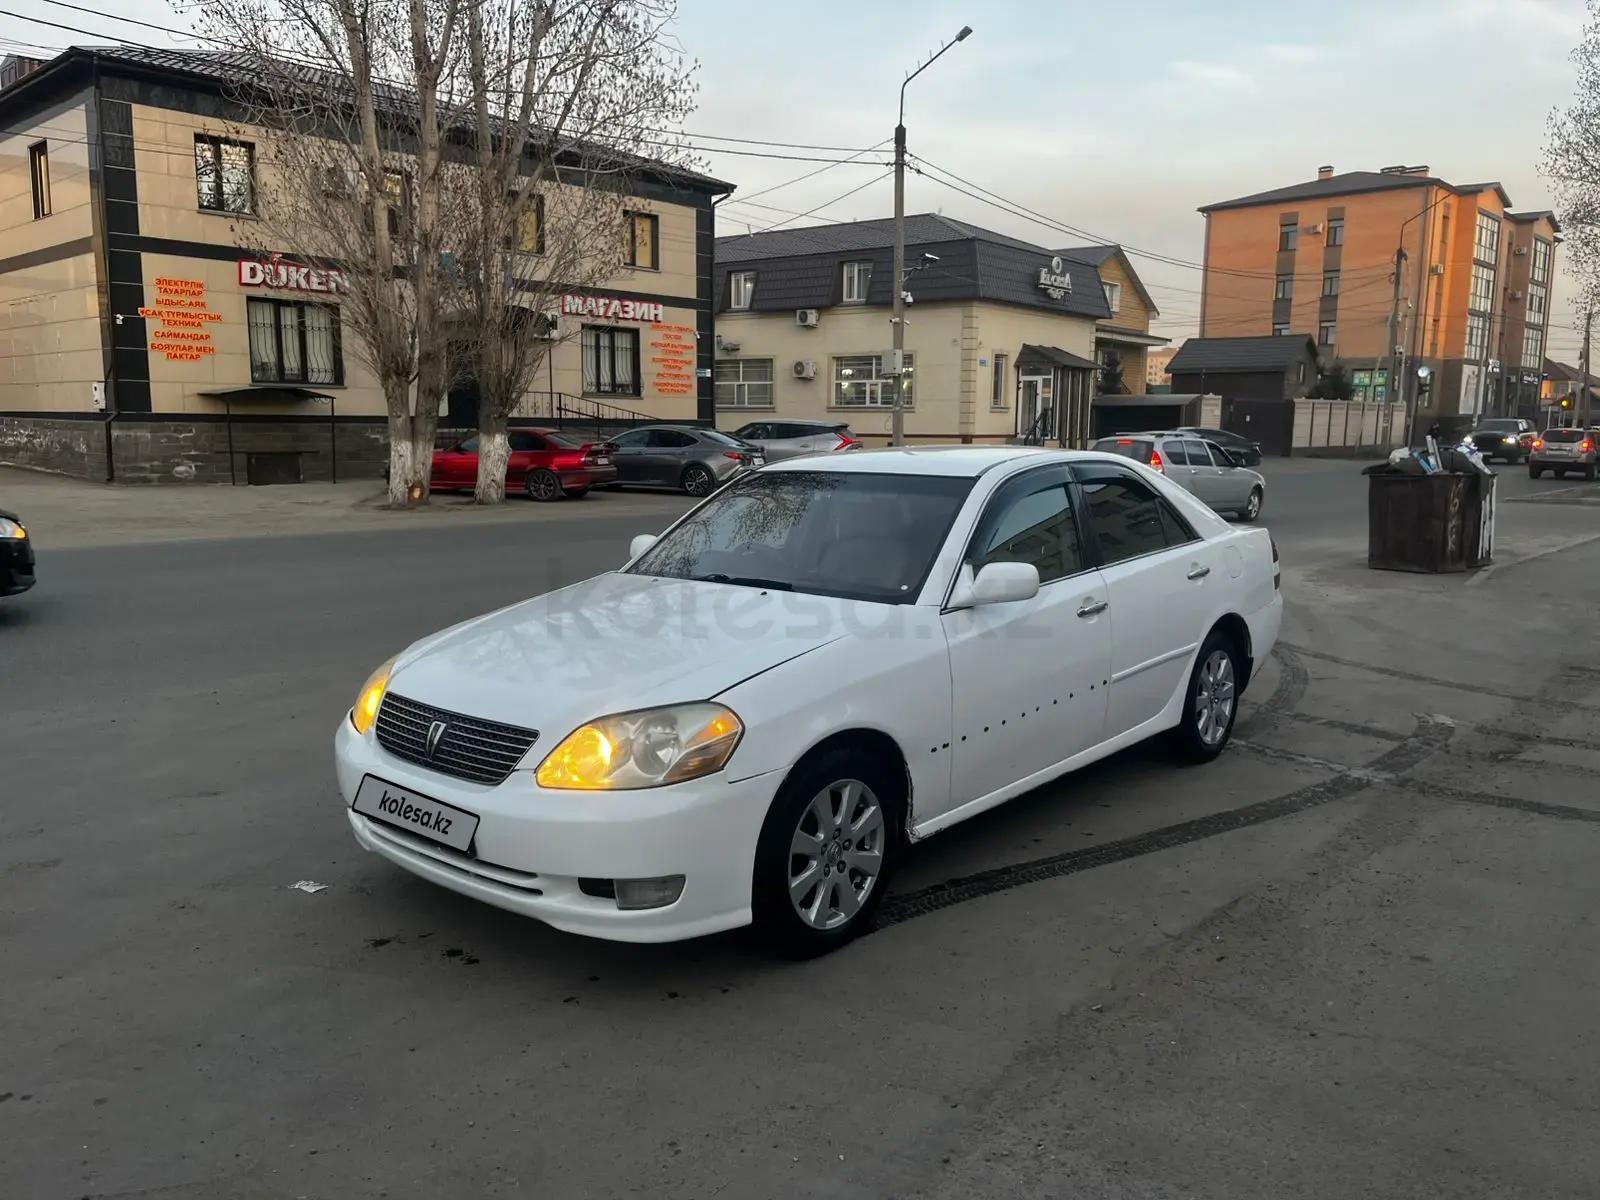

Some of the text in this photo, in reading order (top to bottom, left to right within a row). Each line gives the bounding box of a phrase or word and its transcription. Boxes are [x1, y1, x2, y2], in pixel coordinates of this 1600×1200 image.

[157, 287, 203, 297] ТАУАРЛАР
[562, 294, 664, 322] МАГАЗИН
[160, 318, 202, 328] ТЕХНИКА
[154, 330, 211, 341] САЙМАНДАР
[150, 342, 194, 352] БОЯУЛАР
[165, 352, 201, 361] ЛАКТАР
